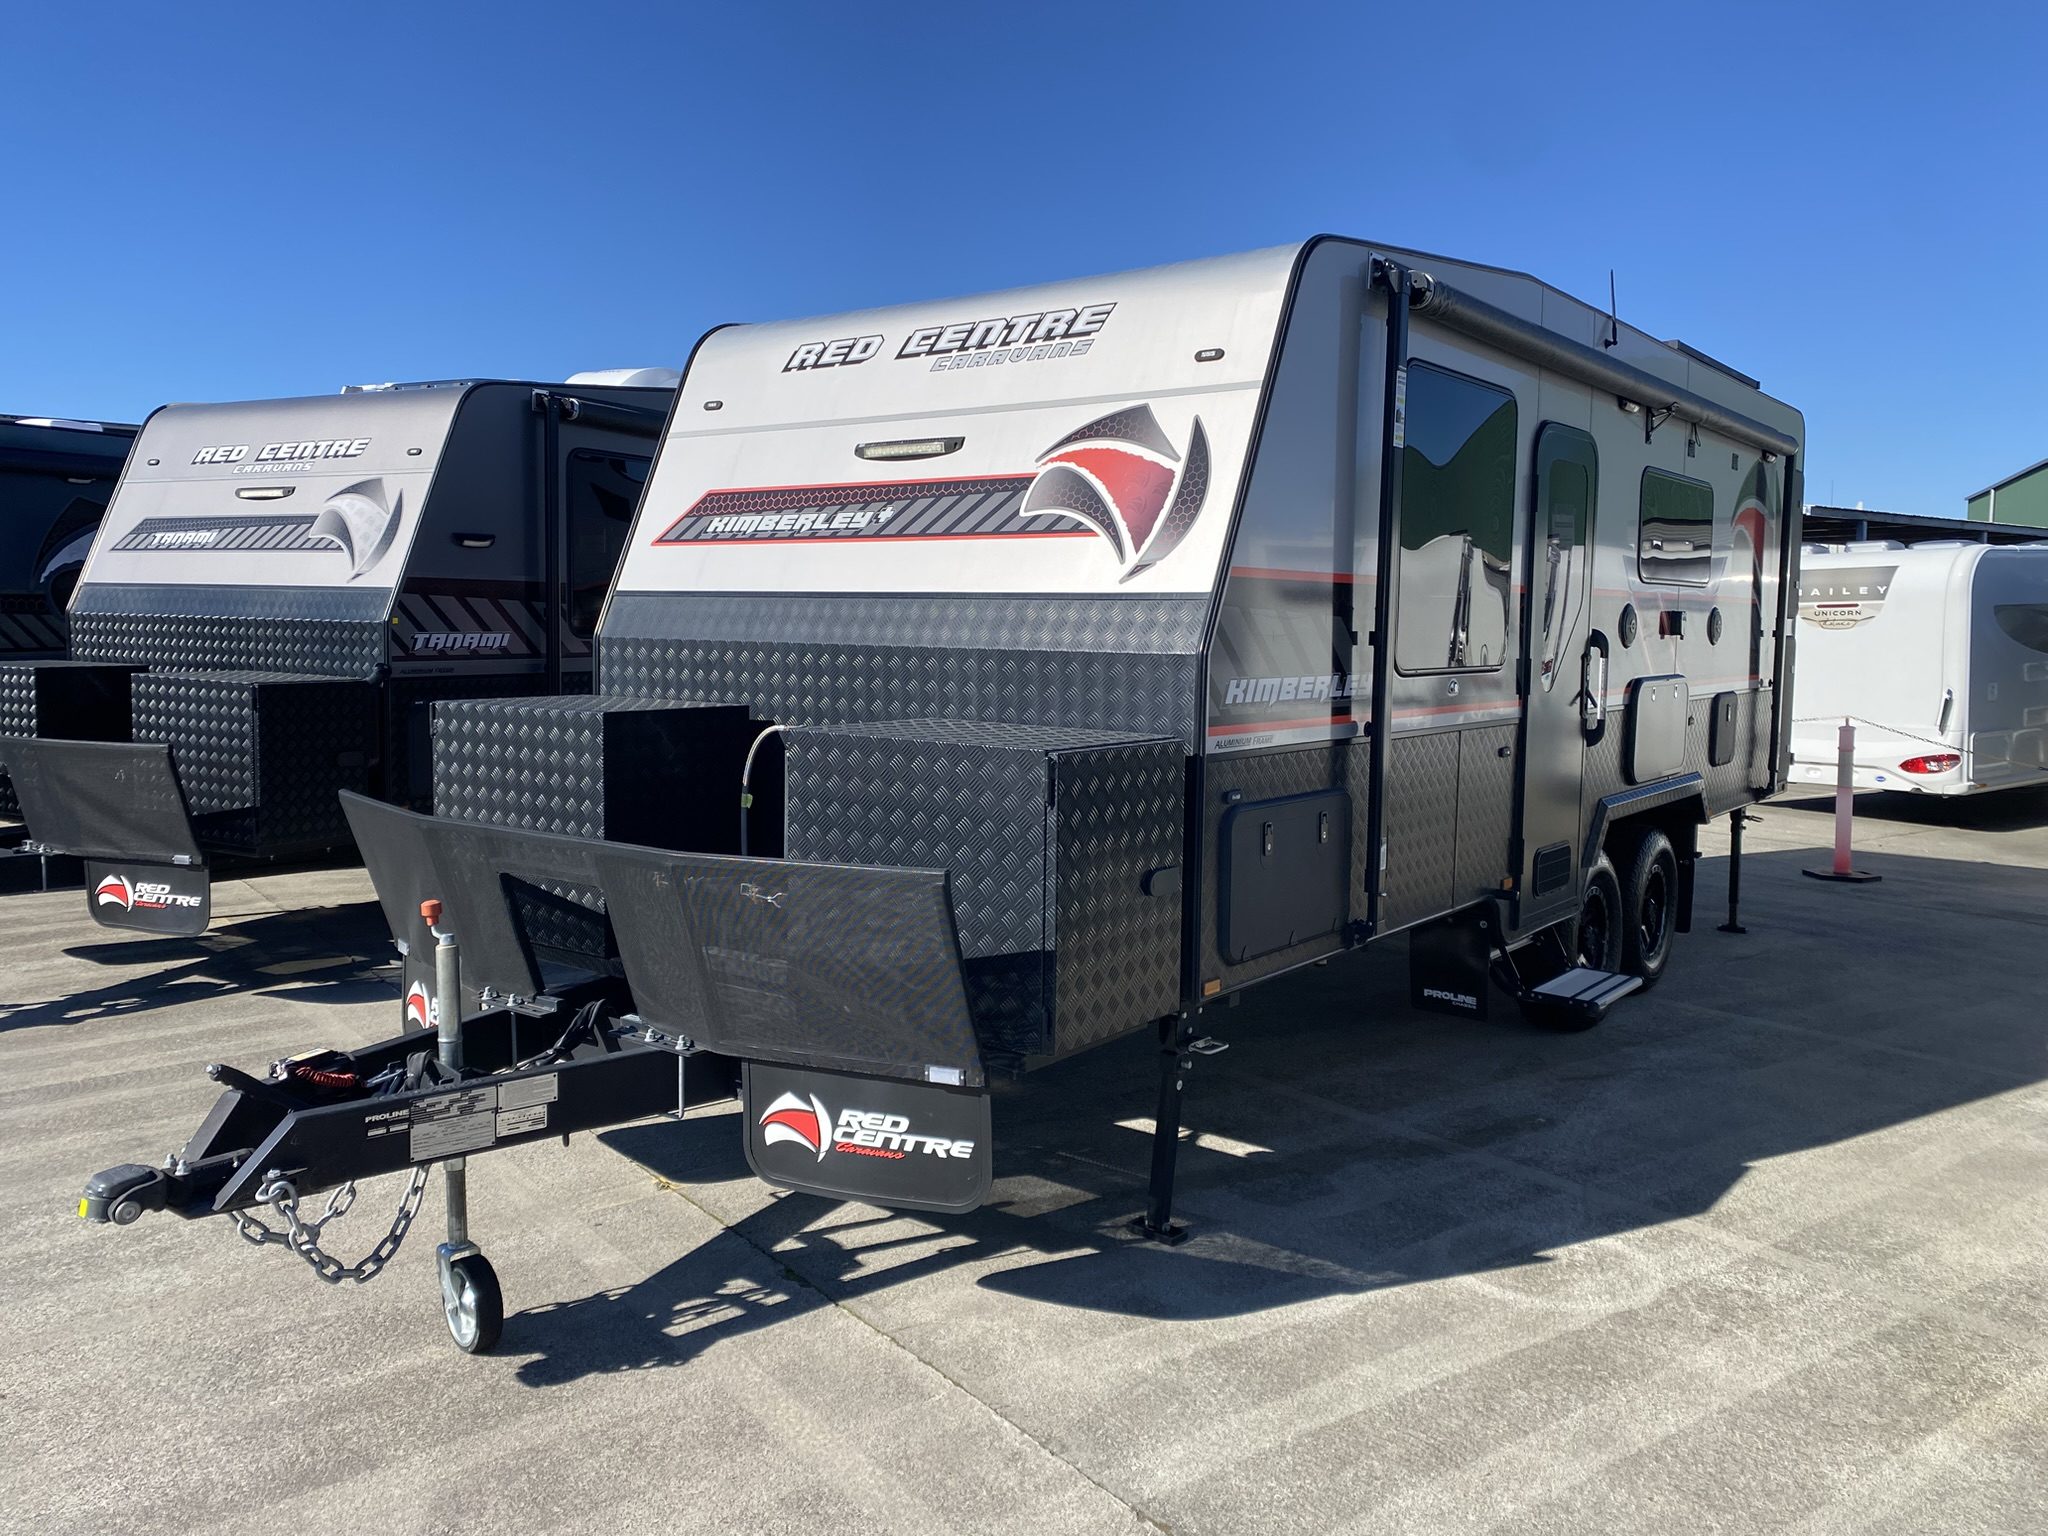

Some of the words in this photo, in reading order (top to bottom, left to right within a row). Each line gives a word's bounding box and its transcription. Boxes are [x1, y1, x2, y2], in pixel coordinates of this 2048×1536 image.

[781, 334, 884, 373] RED
[894, 302, 1118, 360] CENTRE
[929, 339, 1096, 372] CARAVANS
[191, 445, 249, 465] RED
[255, 438, 372, 463] CENTRE
[232, 461, 315, 474] CARAVANS
[150, 531, 219, 546] TANAMI
[411, 632, 511, 650] TANAMI
[134, 882, 171, 895] RED
[133, 892, 202, 907] CENTRE
[1423, 988, 1477, 1005] PROLINE
[365, 1109, 409, 1123] PROLINE
[837, 1108, 910, 1134] RED
[832, 1127, 975, 1159] CENTRE
[835, 1142, 905, 1160] Caravans
